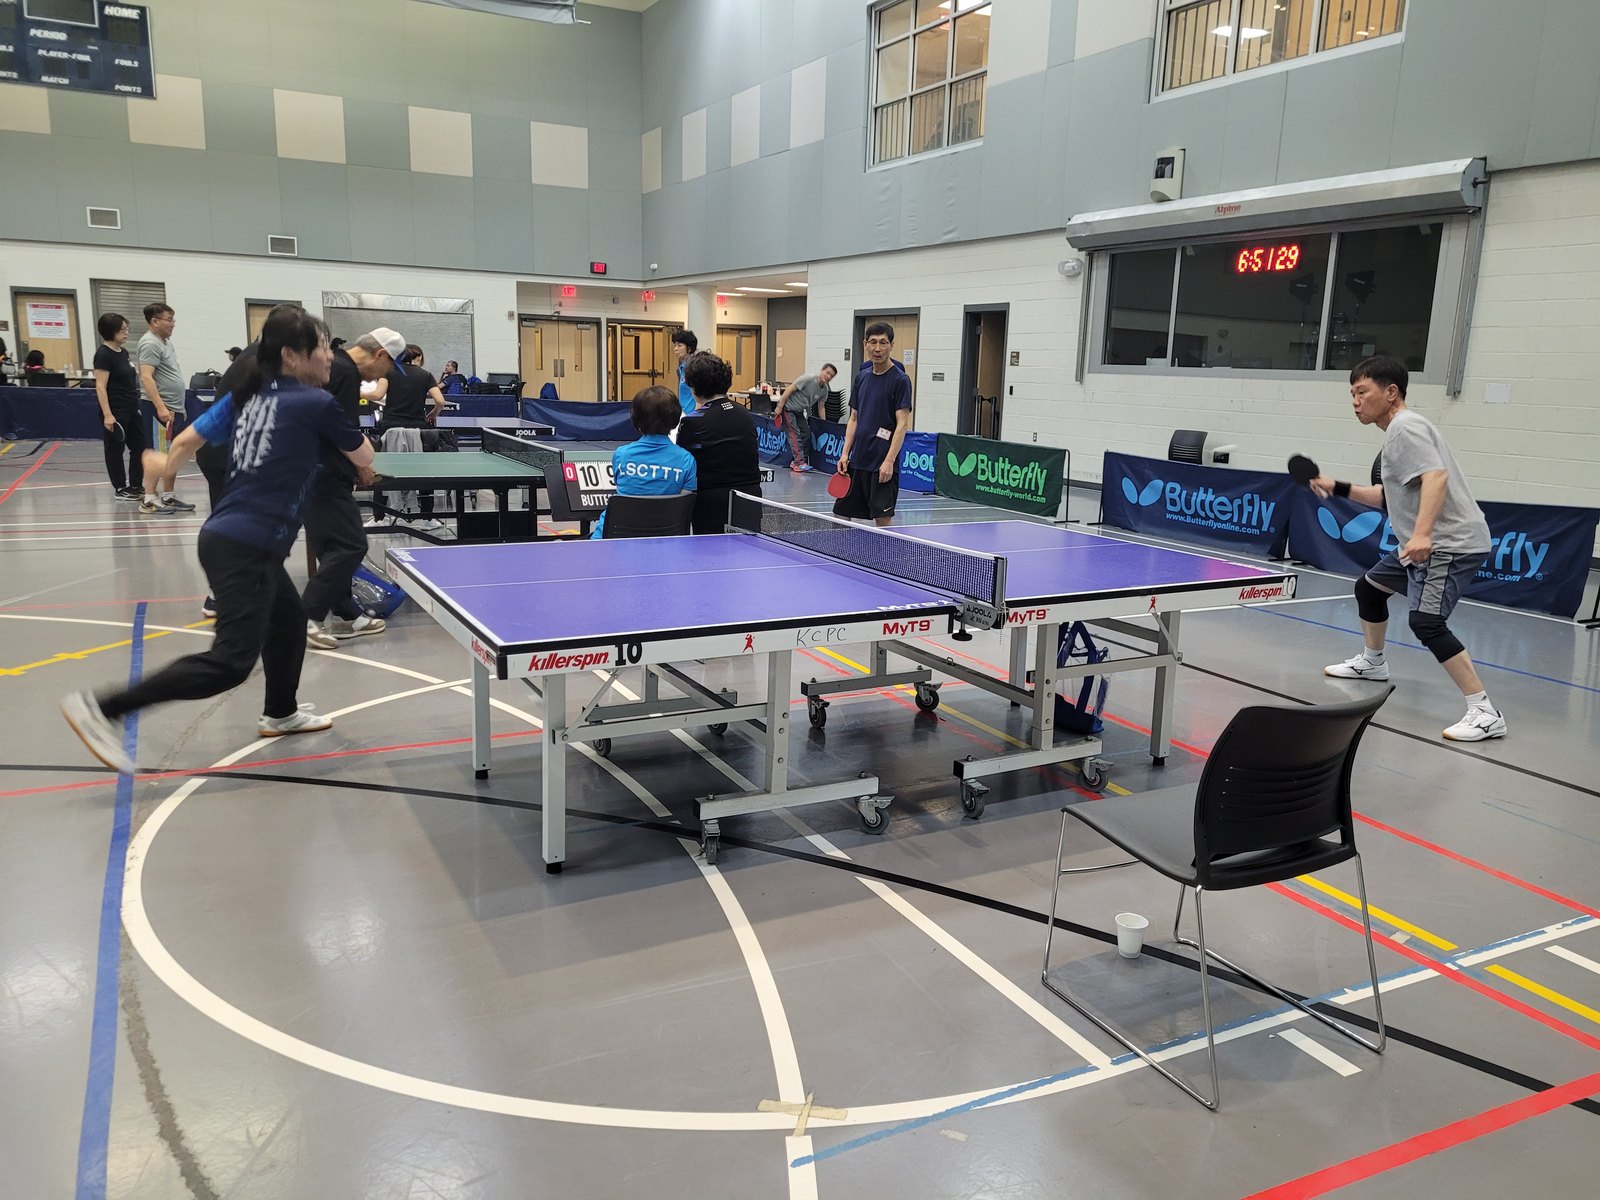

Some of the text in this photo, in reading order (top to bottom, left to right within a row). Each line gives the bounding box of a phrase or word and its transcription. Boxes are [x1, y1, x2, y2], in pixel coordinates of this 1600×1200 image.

[104, 5, 140, 19] HOME
[29, 28, 68, 40] PERIOD
[902, 451, 935, 472] JOOL
[565, 466, 574, 479] 0
[579, 465, 600, 487] 10
[766, 471, 773, 482] 8
[977, 453, 1048, 496] Butterfly
[975, 483, 1046, 503] www.butterfly-world.com
[1165, 481, 1276, 532] Butterfly
[1165, 511, 1260, 536] www.Butterflyonline.com
[1238, 586, 1282, 600] killerspin
[1007, 609, 1047, 624] MyT9
[882, 619, 931, 636] MyT9
[527, 641, 643, 671] killerspin 10
